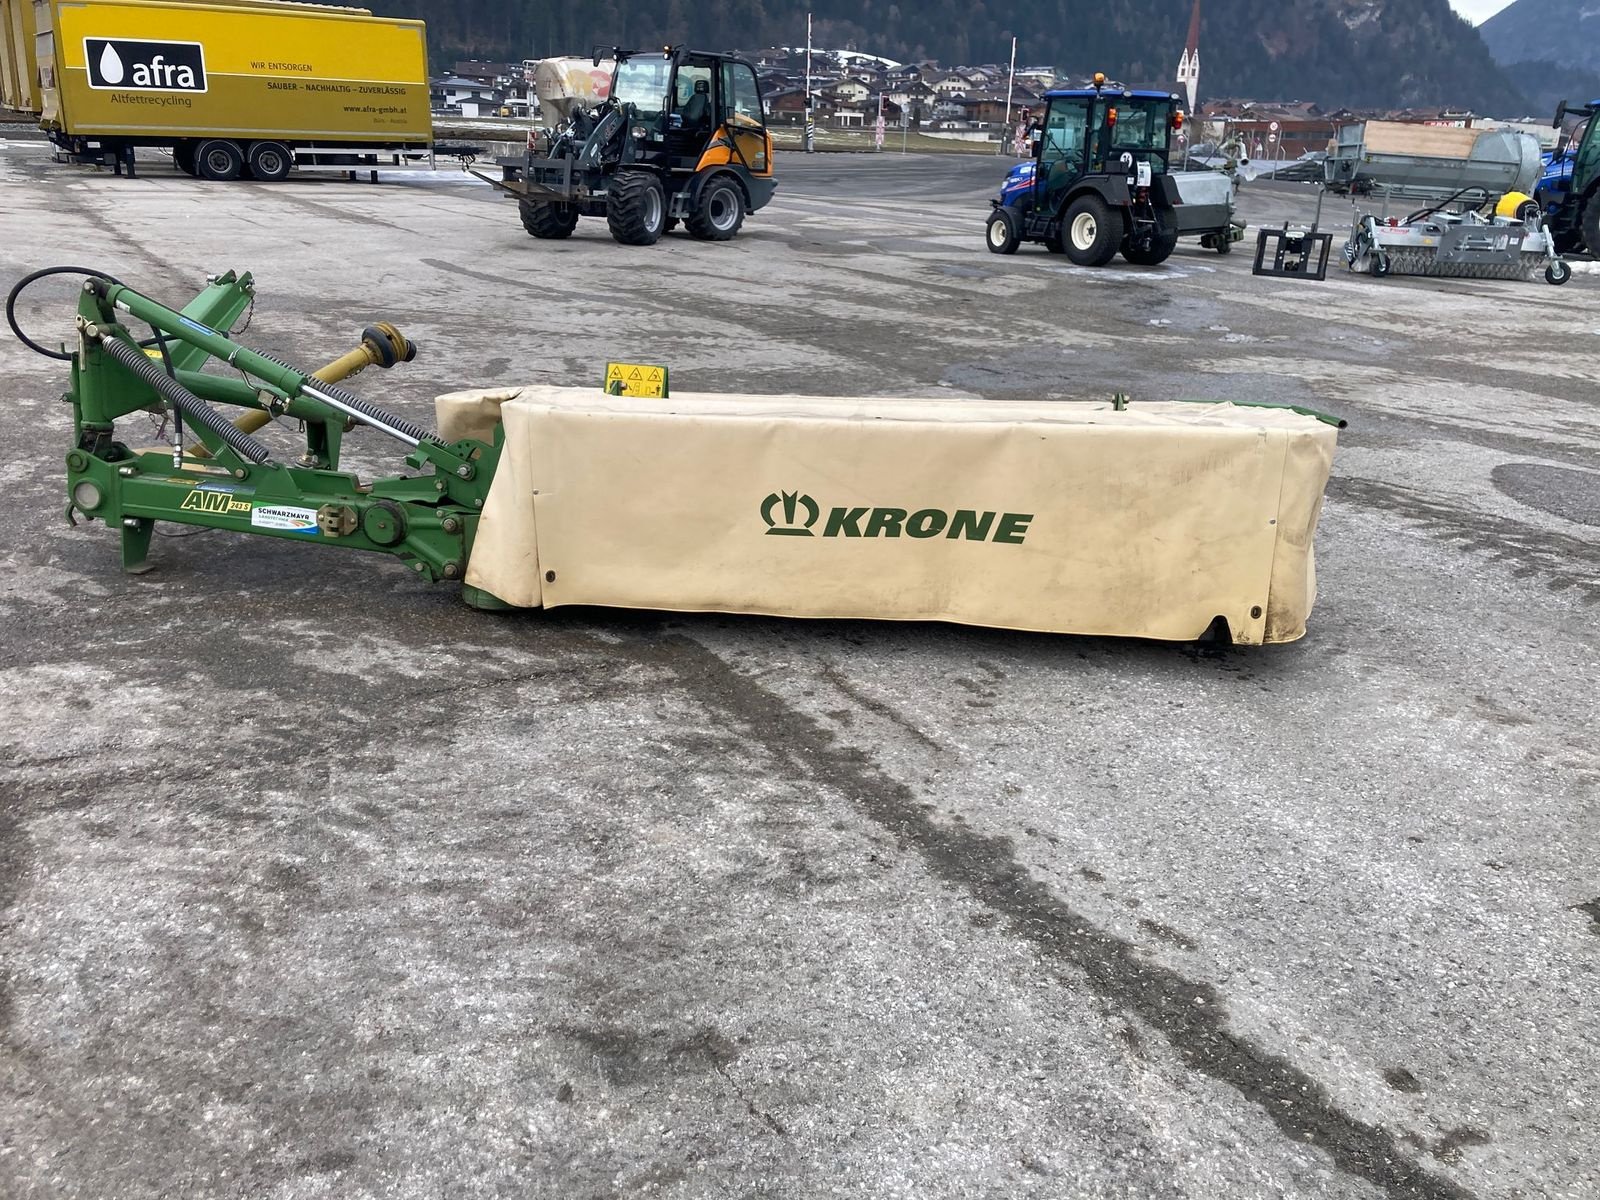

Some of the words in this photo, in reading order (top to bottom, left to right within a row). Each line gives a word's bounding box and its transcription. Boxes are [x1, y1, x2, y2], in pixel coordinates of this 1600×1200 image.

[132, 55, 195, 88] afra
[250, 61, 266, 70] WIR
[268, 62, 313, 72] ENTSORGEN
[267, 82, 297, 91] SAUBER
[305, 84, 351, 93] NACHHALTIG
[358, 86, 407, 96] ZUVERLÄSSIG
[110, 93, 192, 108] Altfettrecycling
[343, 105, 407, 114] www.afra-gmbh.at
[180, 490, 233, 513] AM
[230, 501, 243, 510] 243
[243, 503, 250, 511] S
[258, 507, 310, 520] SCHWARZMAYR
[822, 507, 1034, 545] KRONE
